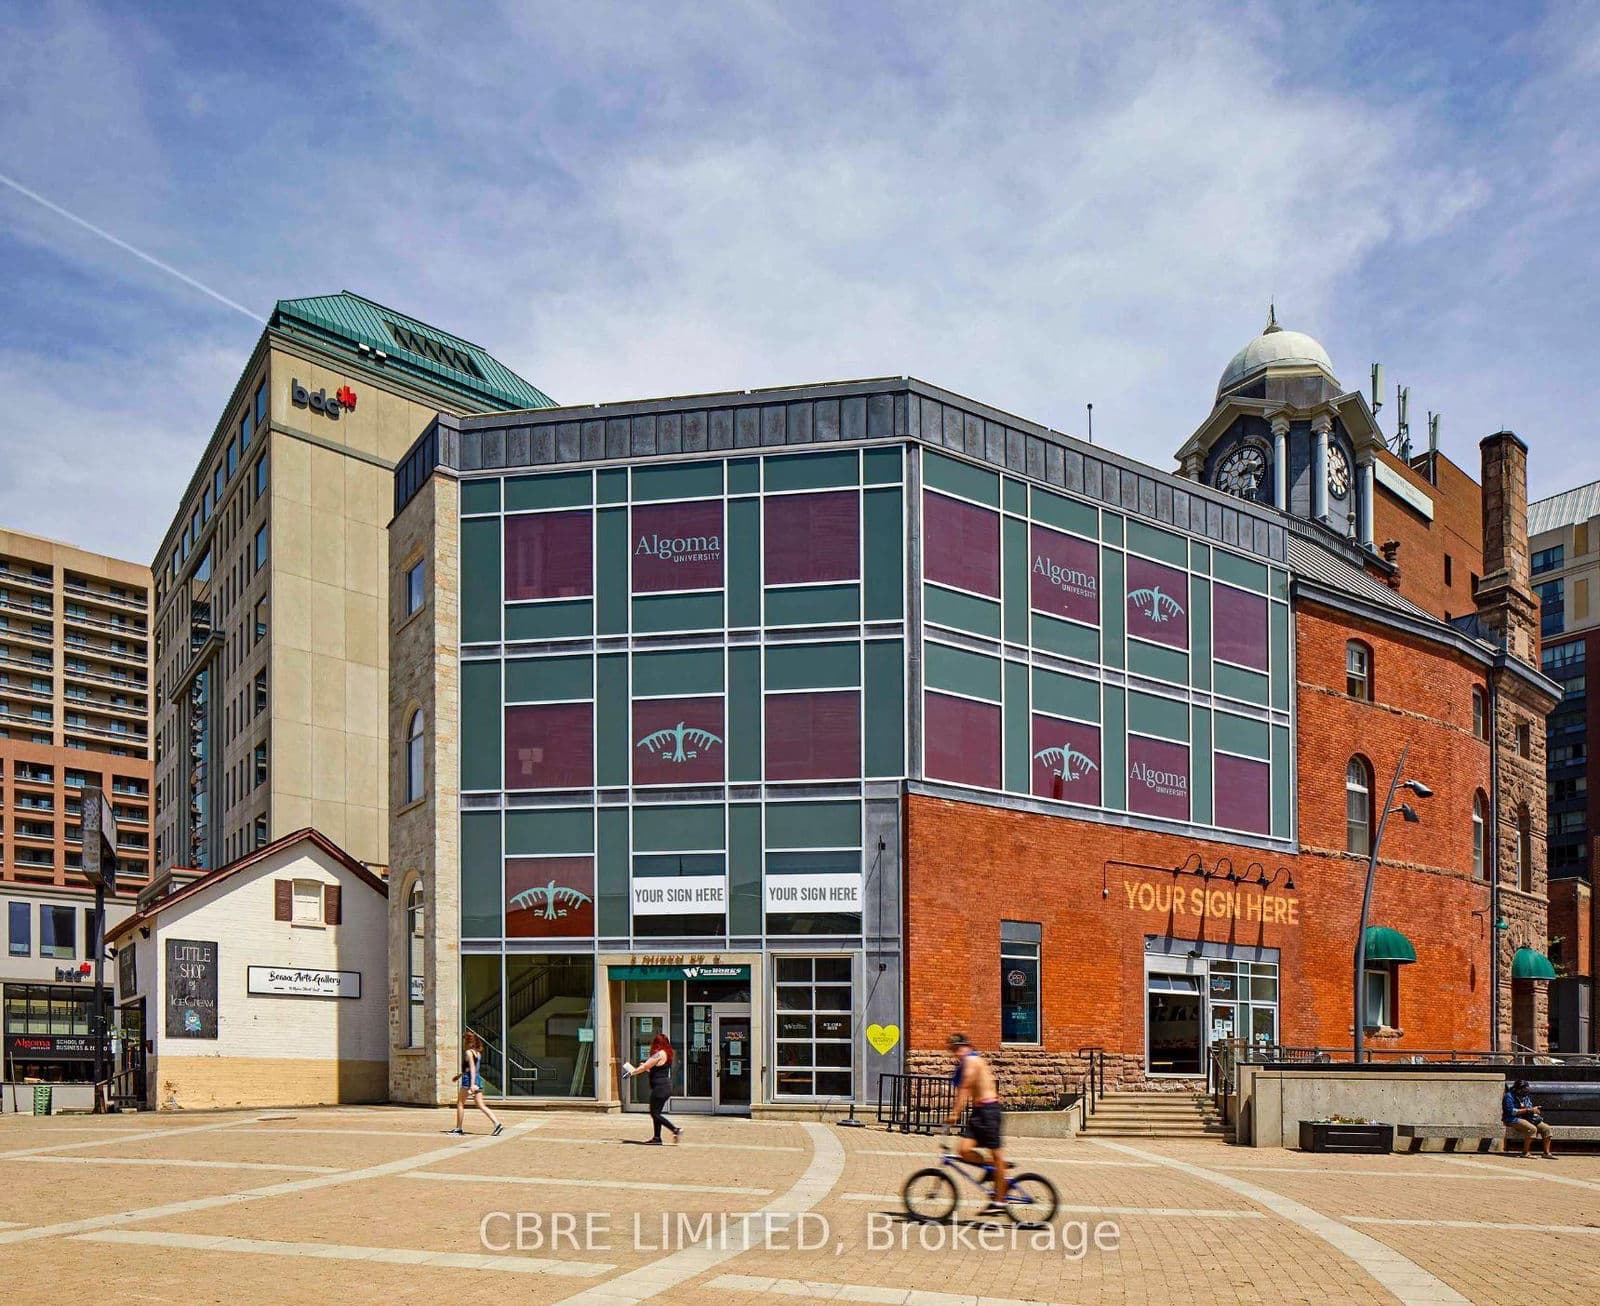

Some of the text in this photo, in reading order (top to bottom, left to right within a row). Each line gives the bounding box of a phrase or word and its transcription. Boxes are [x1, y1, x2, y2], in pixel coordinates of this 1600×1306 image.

[292, 378, 340, 418] bdc
[635, 534, 720, 559] Algoma
[673, 553, 720, 562] UNIVERSITY
[1033, 555, 1097, 590] Algoma
[1061, 584, 1097, 599] UNIVERSITY
[1130, 761, 1187, 789] Algoma
[635, 888, 723, 903] YOUR SIGN HERE
[769, 887, 858, 901] YOUR SIGN HERE
[1123, 880, 1299, 925] YOUR SIGN HERE
[174, 946, 211, 962] LITTLE
[180, 963, 205, 979] SHOP
[294, 971, 312, 983] Arts
[312, 973, 341, 986] Gallery
[14, 1038, 51, 1049] Algoma
